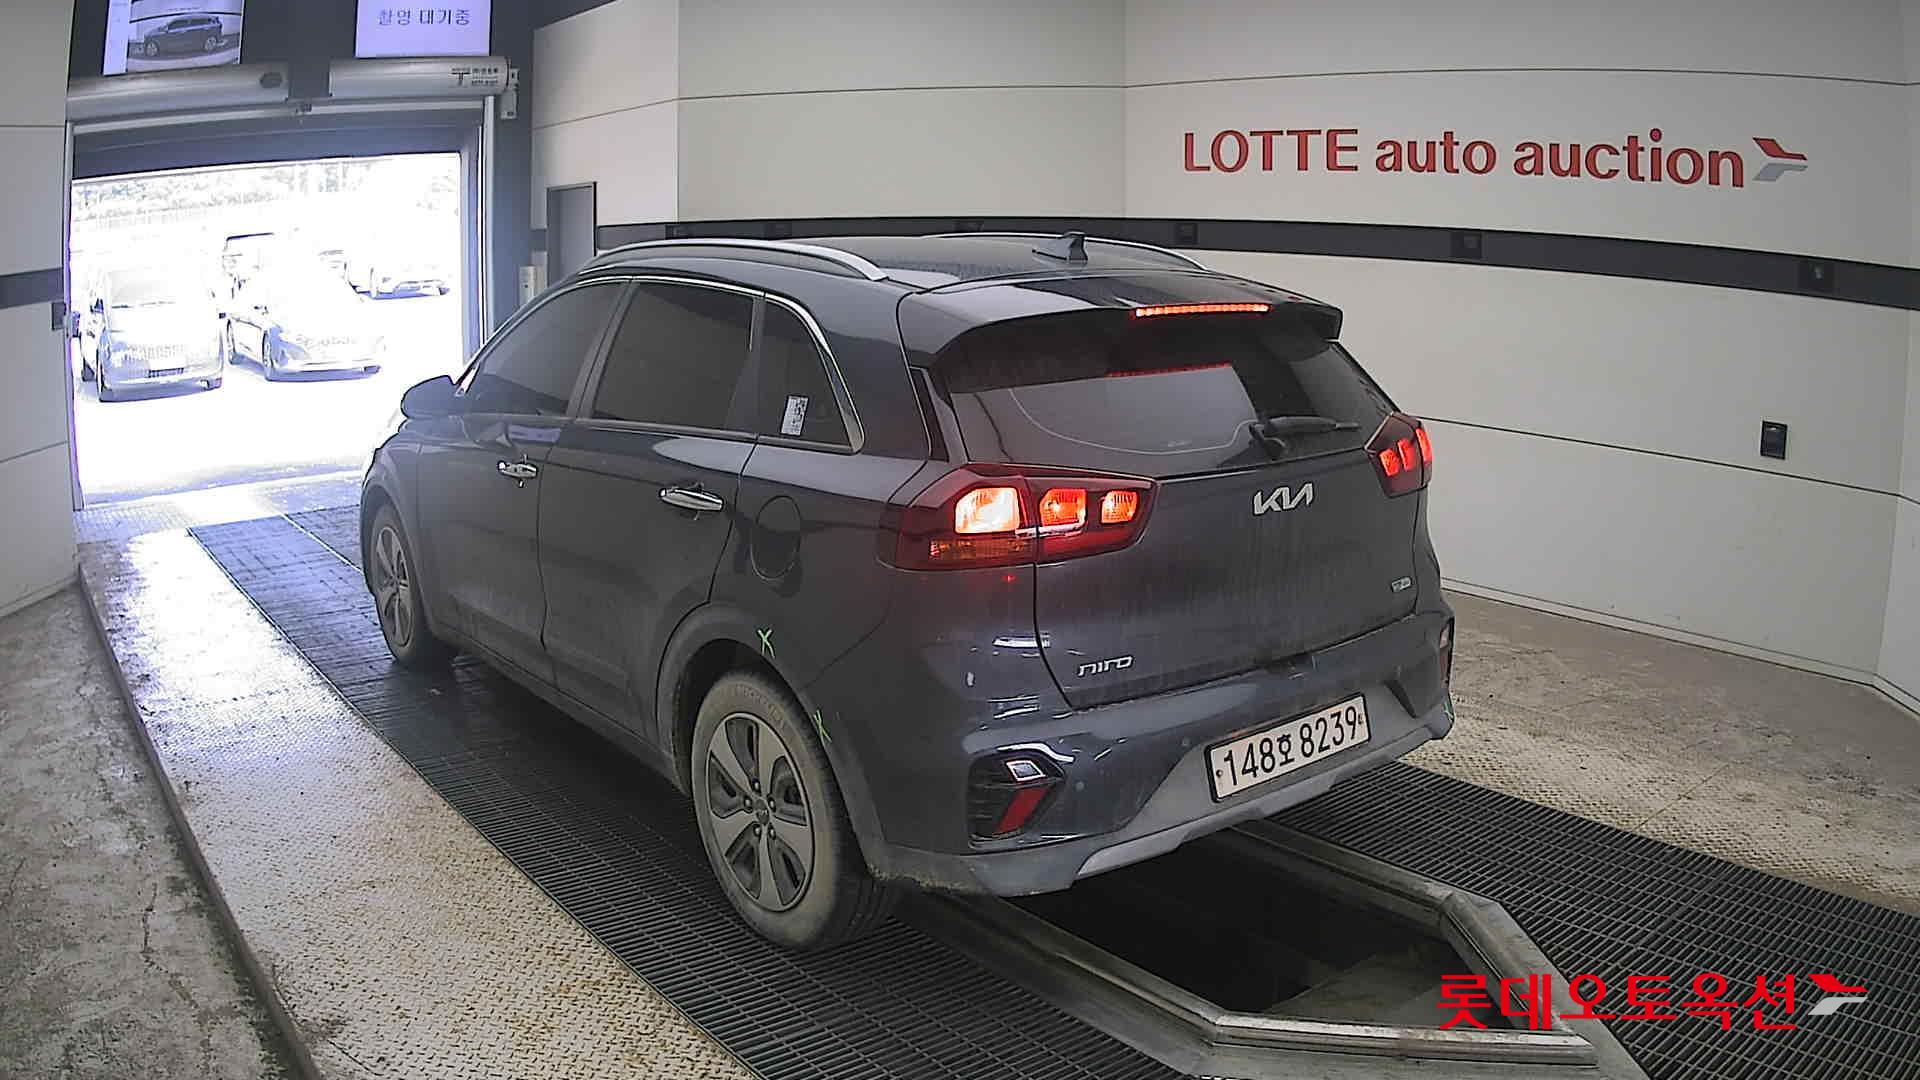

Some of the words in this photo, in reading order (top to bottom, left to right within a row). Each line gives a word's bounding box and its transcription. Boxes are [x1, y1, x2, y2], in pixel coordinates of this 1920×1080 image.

[419, 9, 470, 25] 대기중
[1184, 129, 1359, 172] LOTTE
[1376, 131, 1496, 174] auto
[1513, 128, 1744, 188] auction
[1223, 734, 1295, 786] 148호
[1300, 706, 1357, 757] 8239
